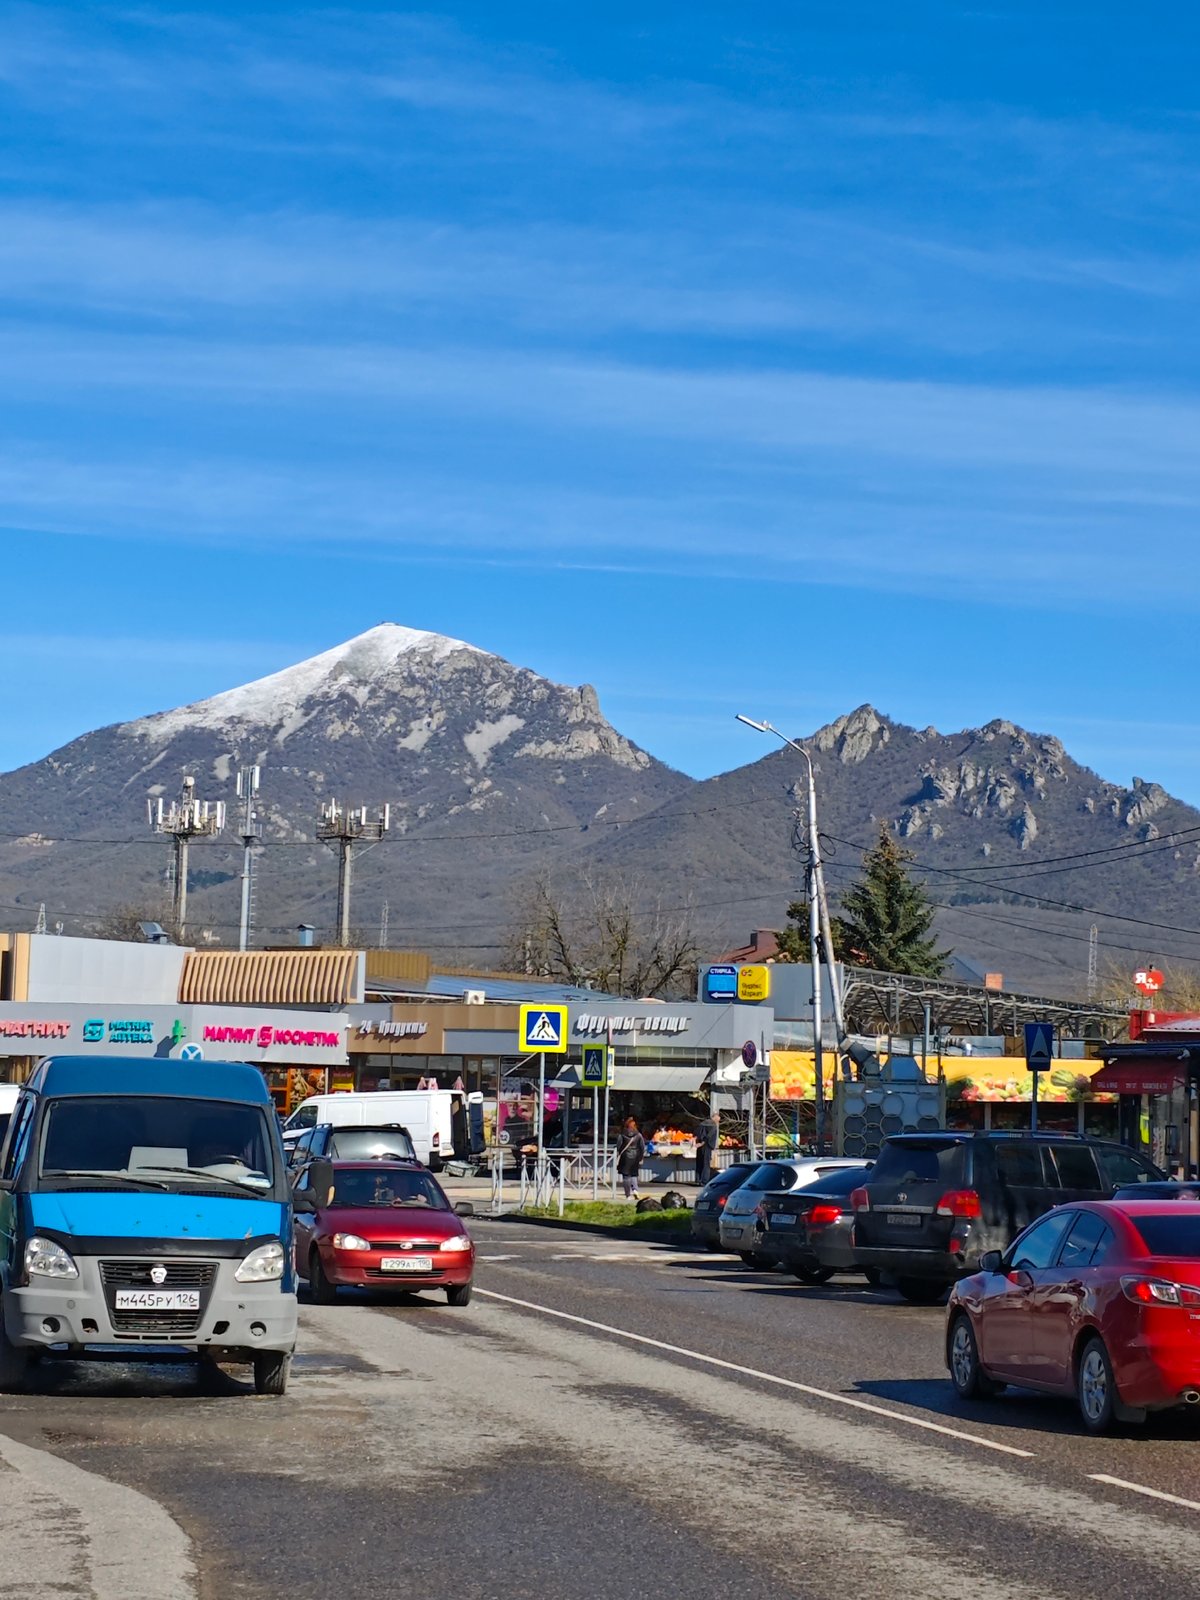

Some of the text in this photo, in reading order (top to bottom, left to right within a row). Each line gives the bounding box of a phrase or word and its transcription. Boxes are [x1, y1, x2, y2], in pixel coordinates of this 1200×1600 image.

[1135, 972, 1146, 984] Я
[0, 1020, 70, 1038] МАГНИТ
[109, 1020, 154, 1031] МАГНИТ
[360, 1020, 428, 1037] 24 Продукты
[643, 1016, 688, 1032] овощи
[108, 1032, 154, 1043] АПТЕКА
[203, 1025, 256, 1043] МАГНИТ
[120, 1293, 194, 1307] М445РУ 126
